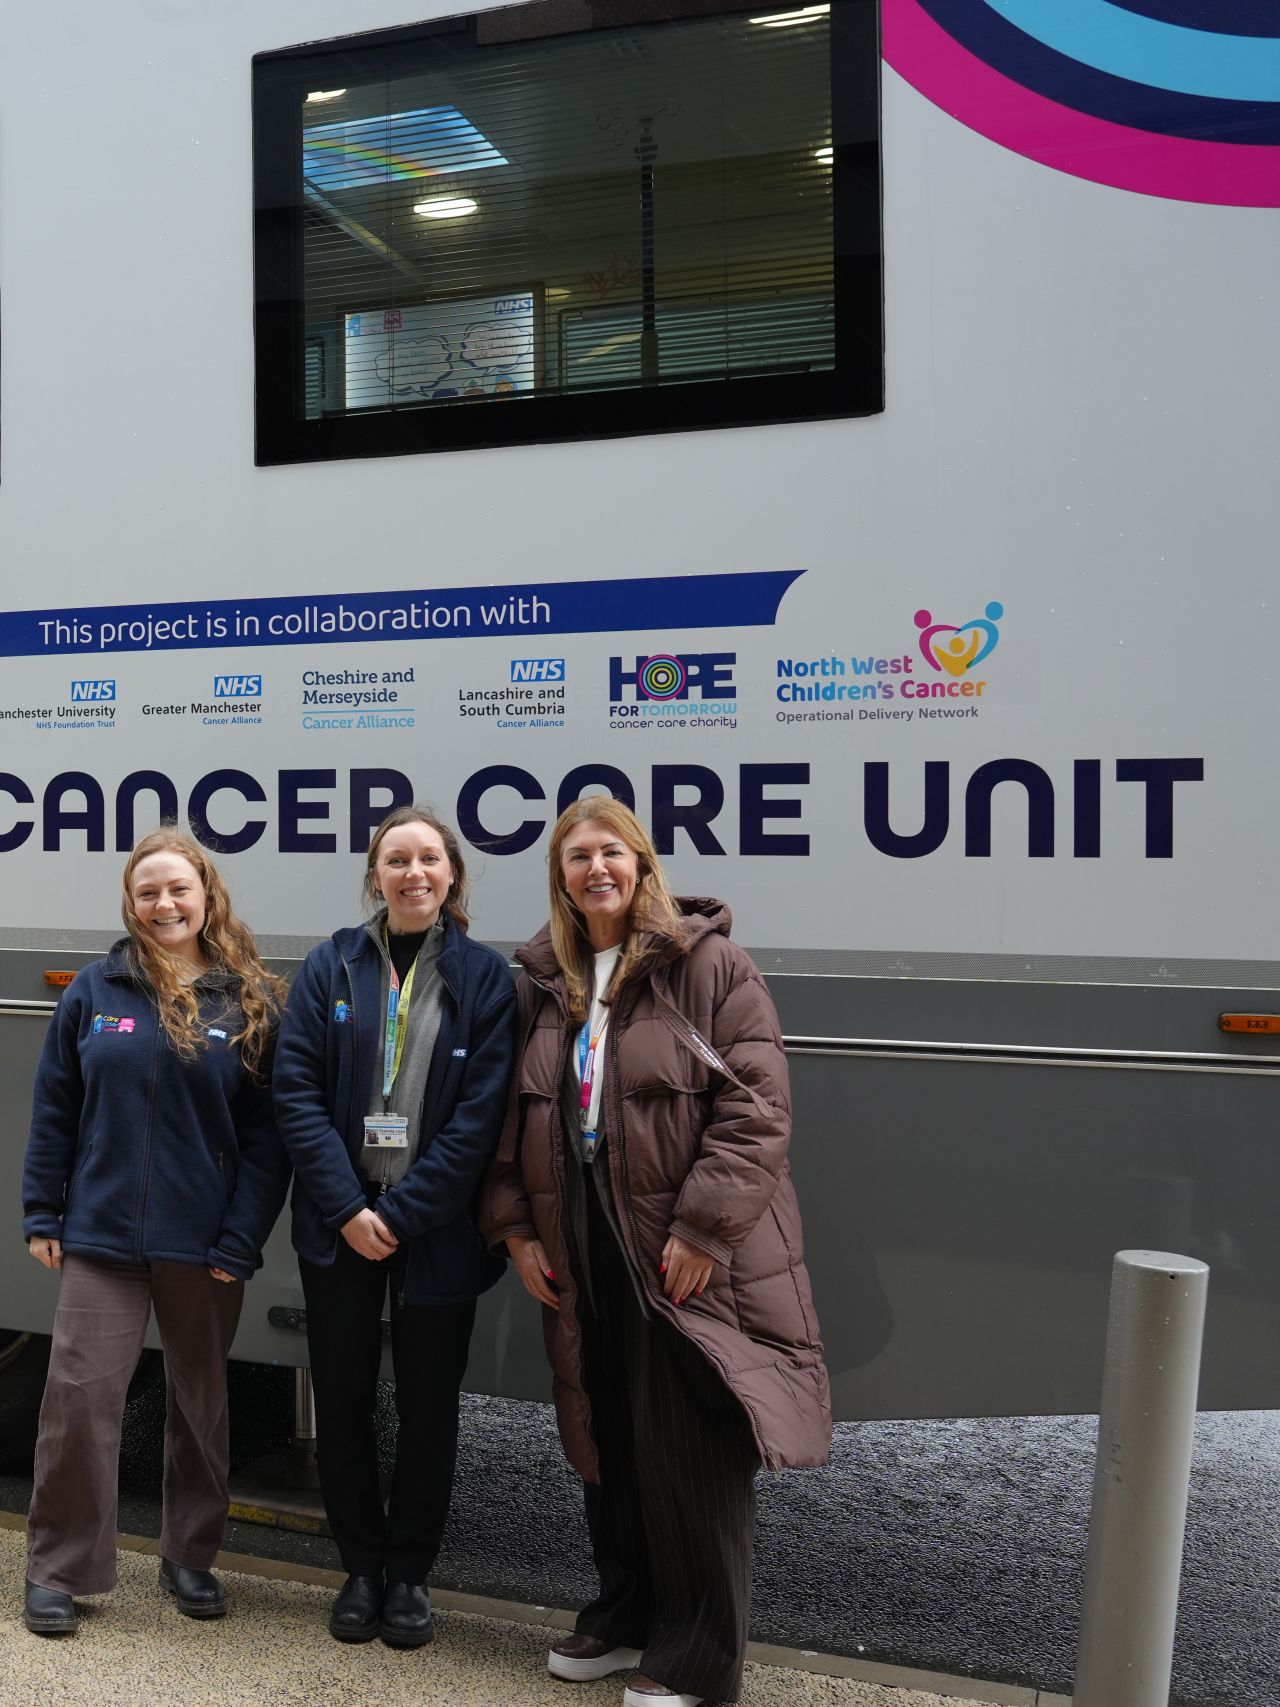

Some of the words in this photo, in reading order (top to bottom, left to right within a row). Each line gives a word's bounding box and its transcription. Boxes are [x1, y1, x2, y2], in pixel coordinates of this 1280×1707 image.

[38, 618, 92, 645] This
[100, 615, 198, 648] project
[206, 611, 227, 638] is
[235, 610, 260, 637] in
[268, 601, 471, 635] collaboration
[480, 596, 551, 625] with
[511, 660, 563, 681] NHS
[777, 657, 845, 678] North
[851, 655, 913, 676] West
[302, 670, 378, 685] Cheshire
[382, 668, 415, 683] and
[609, 652, 736, 701] HOPE
[72, 681, 114, 700] NHS
[215, 676, 260, 696] NHS
[459, 687, 533, 700] Lancashire
[538, 686, 565, 699] and
[777, 681, 894, 703] Children's
[900, 679, 987, 699] Cancer
[303, 688, 398, 707] Merseyside
[57, 705, 116, 719] University
[142, 703, 187, 715] Greater
[190, 702, 261, 715] Manchester
[460, 703, 500, 716] South
[505, 702, 565, 715] Cumbria
[776, 709, 854, 723] Operational
[858, 708, 914, 722] Delivery
[918, 706, 979, 720] Network
[36, 721, 51, 729] NHS
[54, 720, 95, 729] Foundation
[97, 720, 115, 728] Trust
[202, 717, 228, 725] Cancer
[231, 716, 262, 724] Alliance
[303, 717, 353, 729] Cancer
[356, 715, 415, 728] Alliance
[497, 720, 527, 728] Cancer
[529, 718, 564, 727] Alliance
[609, 719, 653, 729] cancer
[657, 719, 687, 728] care
[690, 716, 737, 729] charity
[864, 758, 1204, 858] UNIT
[208, 1028, 227, 1039] NHS
